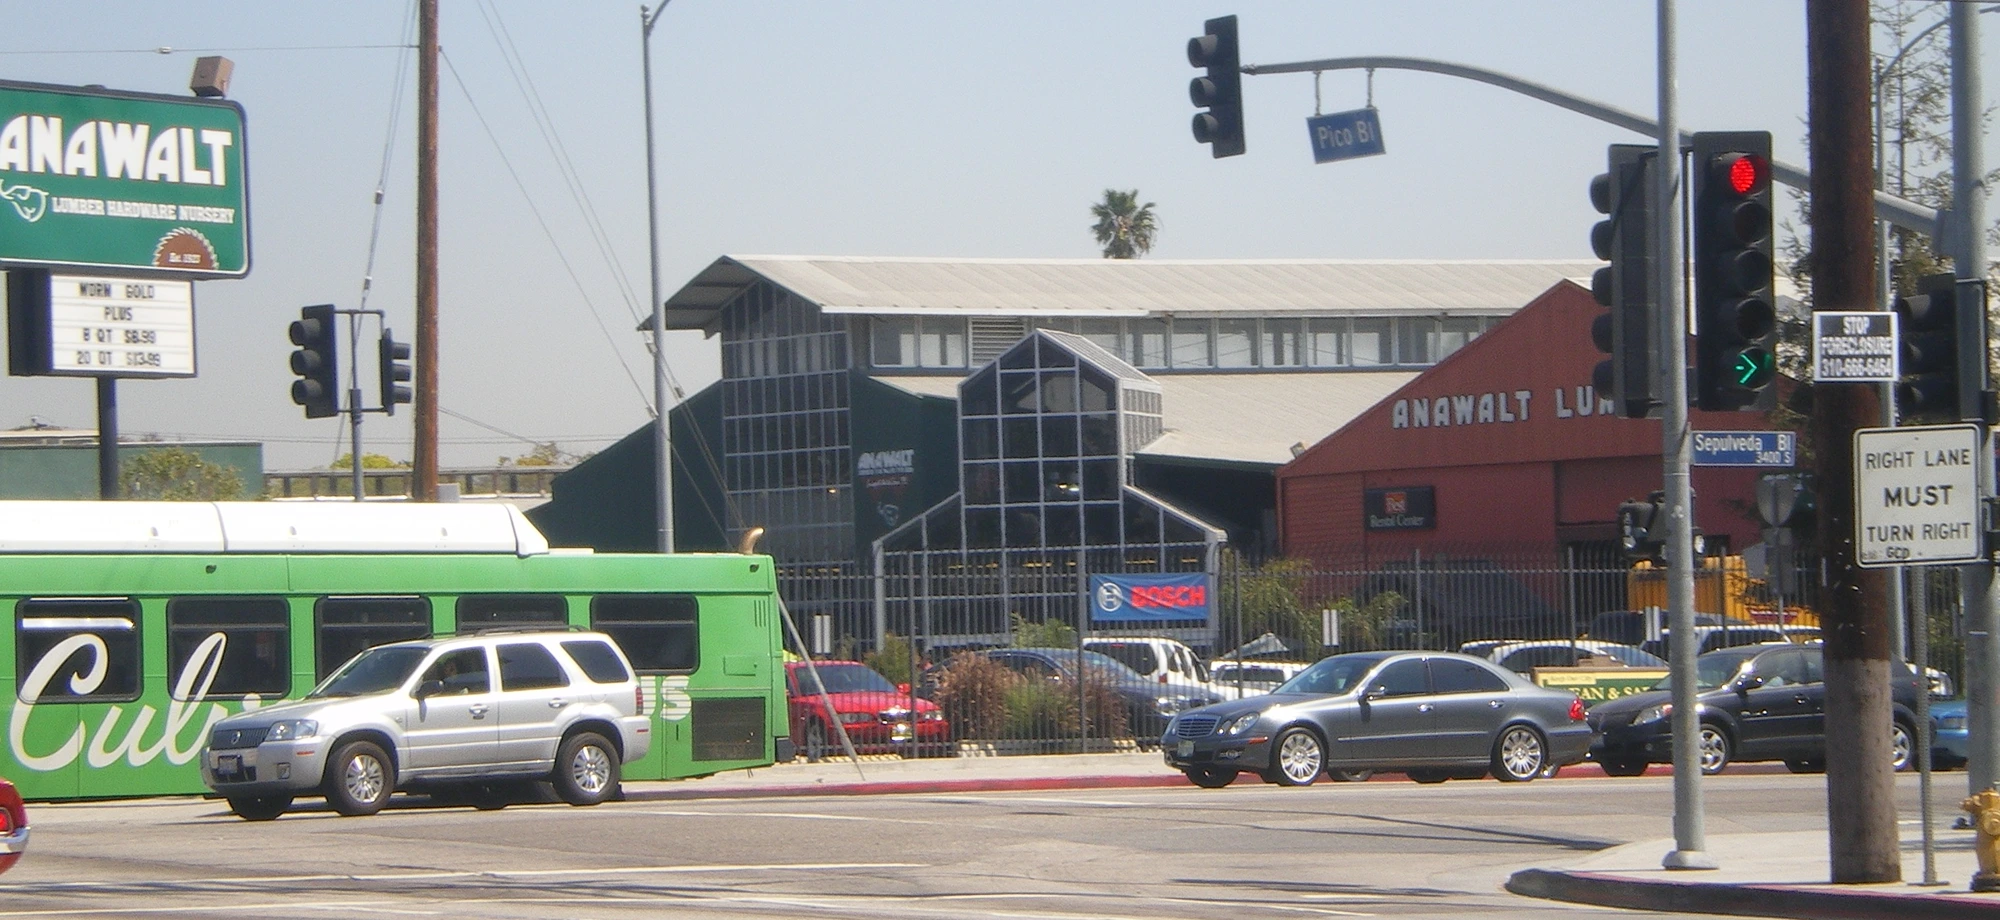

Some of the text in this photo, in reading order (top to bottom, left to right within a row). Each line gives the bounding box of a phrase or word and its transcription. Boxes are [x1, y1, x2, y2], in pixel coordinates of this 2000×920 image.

[1317, 125, 1353, 149] Pico
[0, 114, 232, 186] ANAWALT
[51, 197, 235, 224] LUMBER HARDWARE NURSERY
[125, 285, 154, 299] GOLD
[104, 306, 133, 321] PLUS
[83, 328, 90, 342] 8
[97, 329, 113, 343] QT
[1843, 316, 1870, 335] STOP
[1821, 336, 1893, 355] FORECLOSURE
[76, 351, 91, 365] 20
[98, 351, 113, 366] QT
[1821, 357, 1892, 377] 310-666-6464
[1392, 390, 1531, 429] ANAWALT
[1695, 433, 1763, 456] Sepulveda
[1755, 451, 1792, 464] 3400 S
[1865, 448, 1971, 470] RIGHT LANE
[1884, 485, 1953, 508] MUST
[1866, 522, 1970, 543] TURN RIGHT
[1130, 585, 1206, 609] BOSCH
